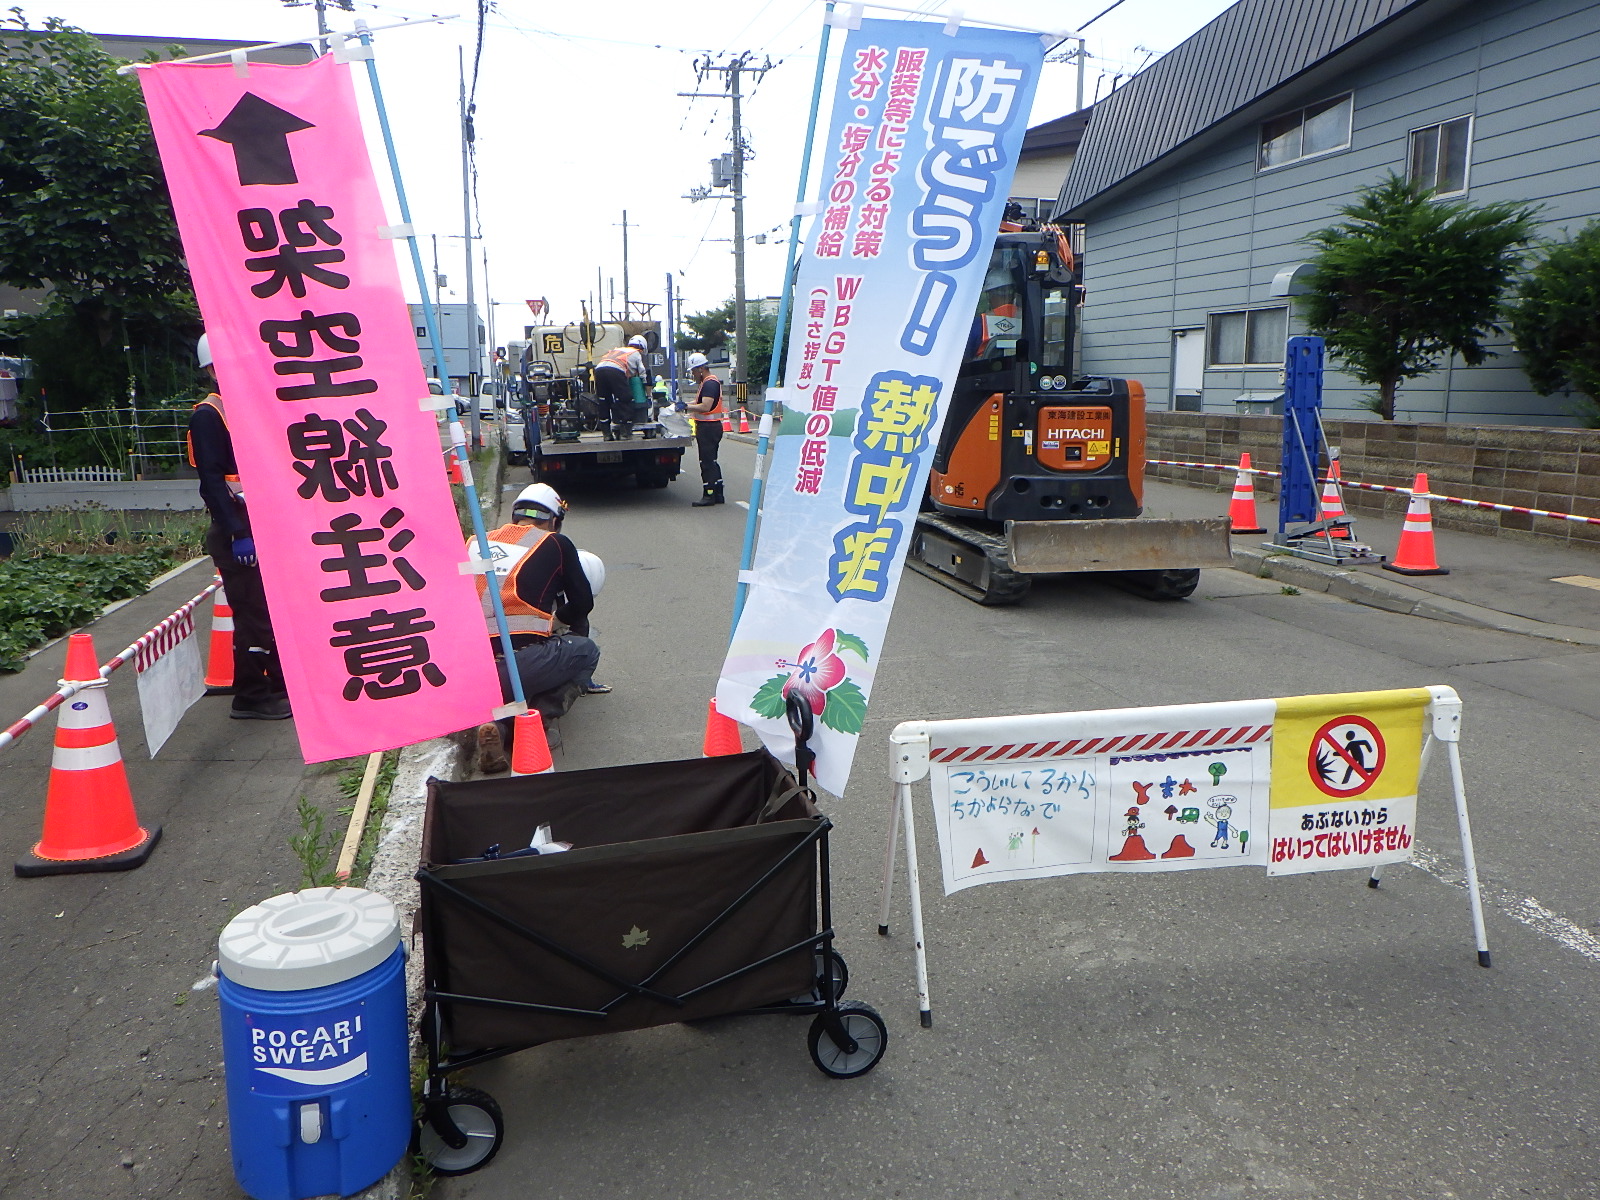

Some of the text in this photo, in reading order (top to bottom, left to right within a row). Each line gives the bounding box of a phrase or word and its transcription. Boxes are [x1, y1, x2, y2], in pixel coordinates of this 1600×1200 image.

[815, 47, 886, 258] 水分・塩分の補給
[851, 48, 926, 258] 服装等による対策
[545, 334, 563, 352] 危
[795, 276, 861, 495] WBGT値の低減
[1048, 428, 1105, 439] HITACHI
[1301, 807, 1388, 831] あぶないから
[1271, 824, 1412, 863] はいってはいけません
[251, 1015, 363, 1047] POCARI
[253, 1035, 354, 1064] SWEAT
